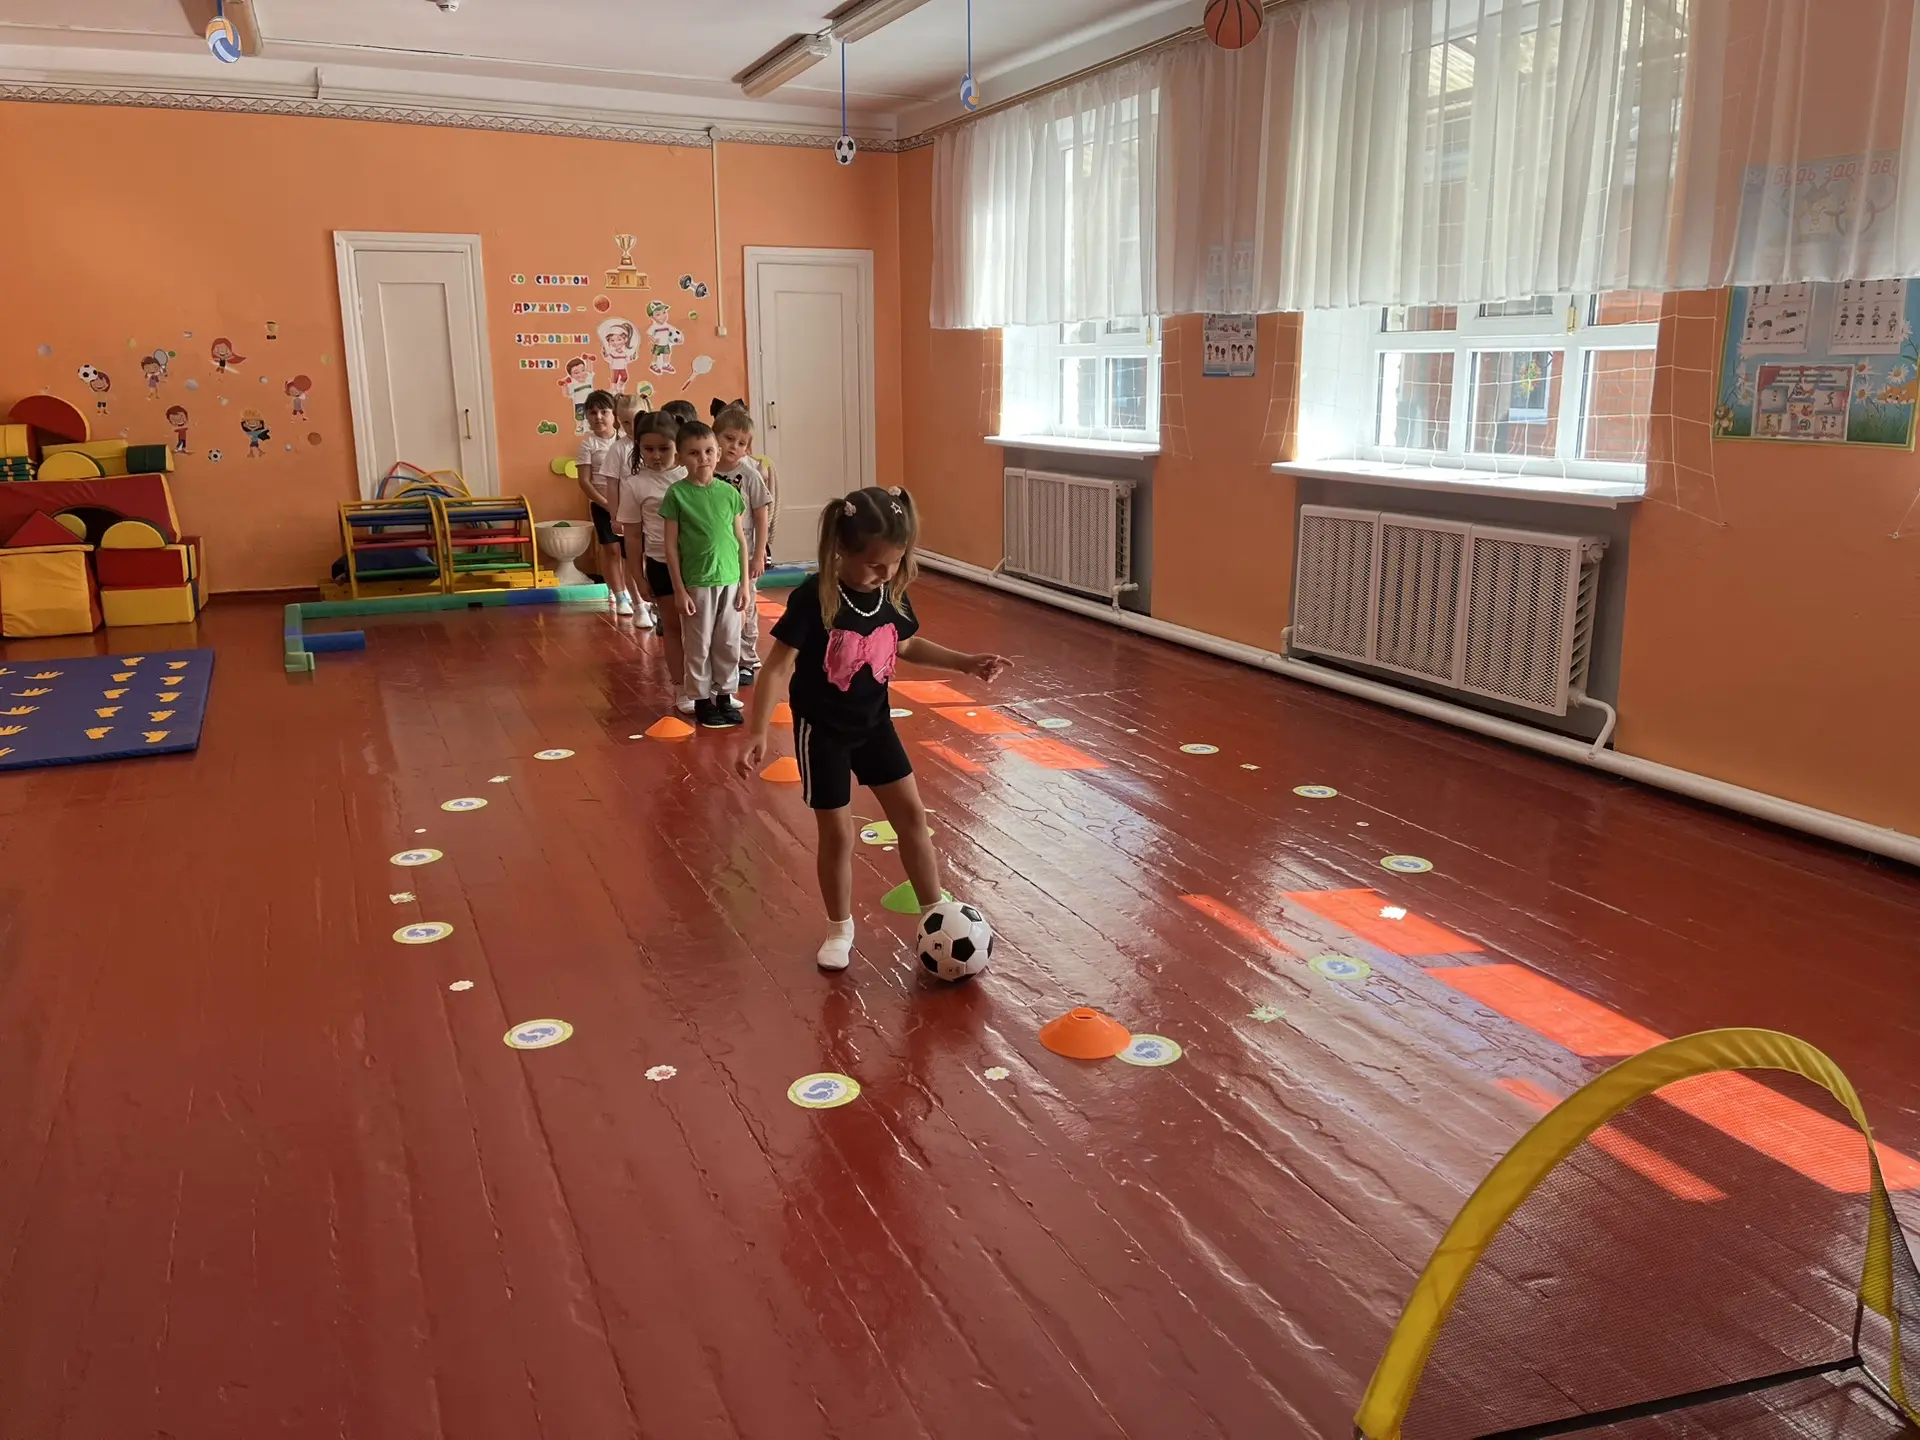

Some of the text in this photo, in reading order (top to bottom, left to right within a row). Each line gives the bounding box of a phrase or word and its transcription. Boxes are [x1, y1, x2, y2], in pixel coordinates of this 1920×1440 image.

[510, 274, 588, 285] СО СПОРТОМ
[610, 275, 617, 286] 2
[639, 276, 646, 287] 3
[513, 302, 570, 313] ДРУЖИТЬ
[516, 333, 589, 345] ЗДОРОВЫМИ
[520, 359, 558, 369] БЫТЬ!
